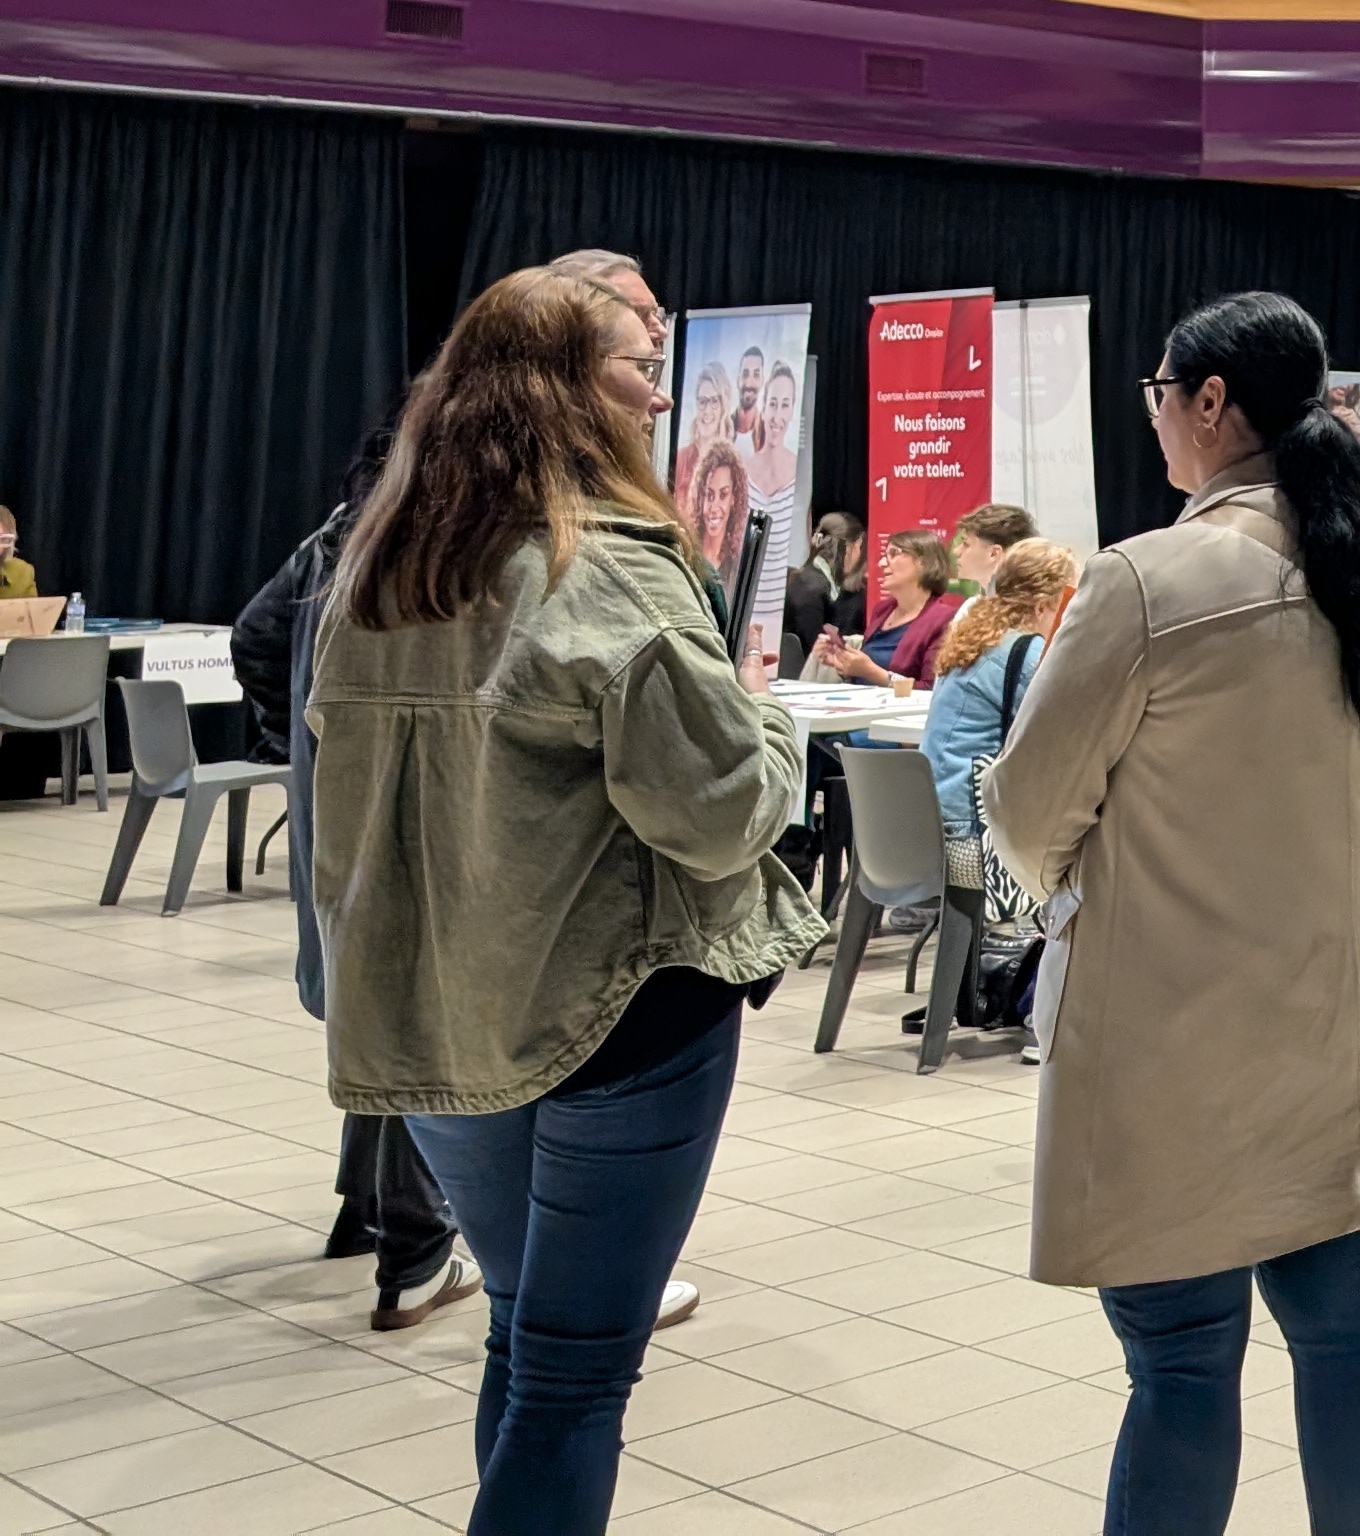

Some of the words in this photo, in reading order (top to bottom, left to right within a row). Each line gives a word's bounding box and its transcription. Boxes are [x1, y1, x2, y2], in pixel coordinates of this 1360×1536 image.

[880, 320, 924, 341] Adecco
[894, 414, 923, 433] Nous
[925, 412, 966, 432] faisons
[909, 436, 952, 460] grandir
[894, 462, 924, 478] votre
[925, 460, 965, 478] talent.
[147, 659, 195, 672] VULTUS
